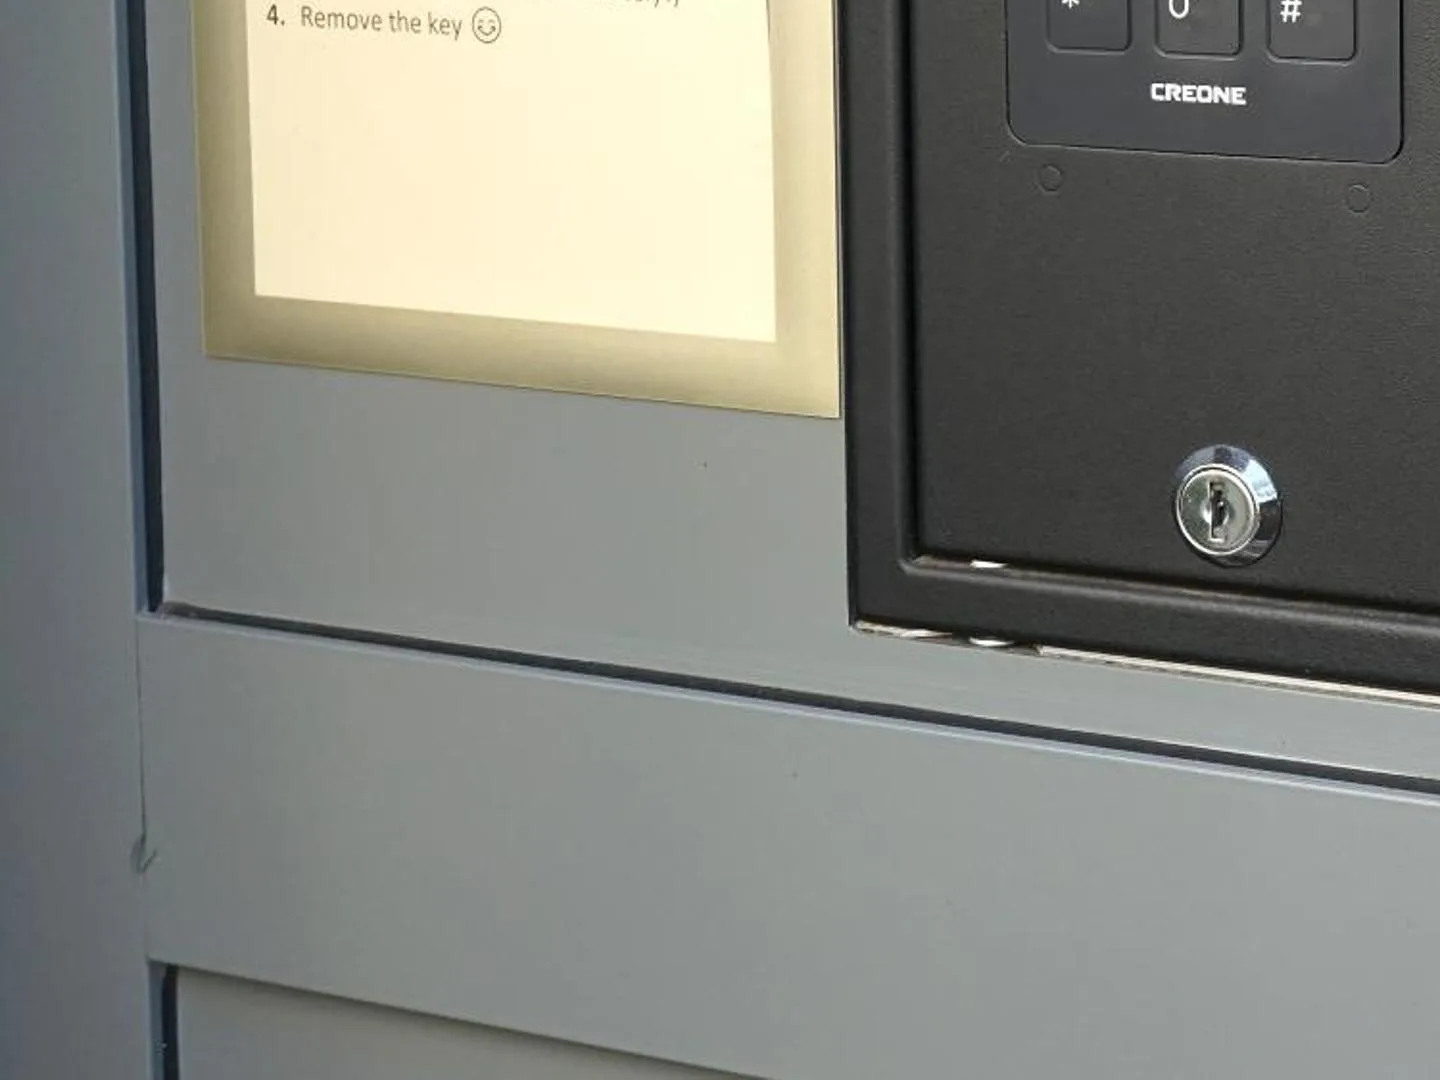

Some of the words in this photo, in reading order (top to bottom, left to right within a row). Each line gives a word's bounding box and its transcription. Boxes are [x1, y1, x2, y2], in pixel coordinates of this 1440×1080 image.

[267, 5, 285, 26] 4.
[300, 6, 382, 32] Remove
[388, 9, 421, 33] the
[427, 10, 462, 39] key
[1150, 82, 1247, 105] CREONE
